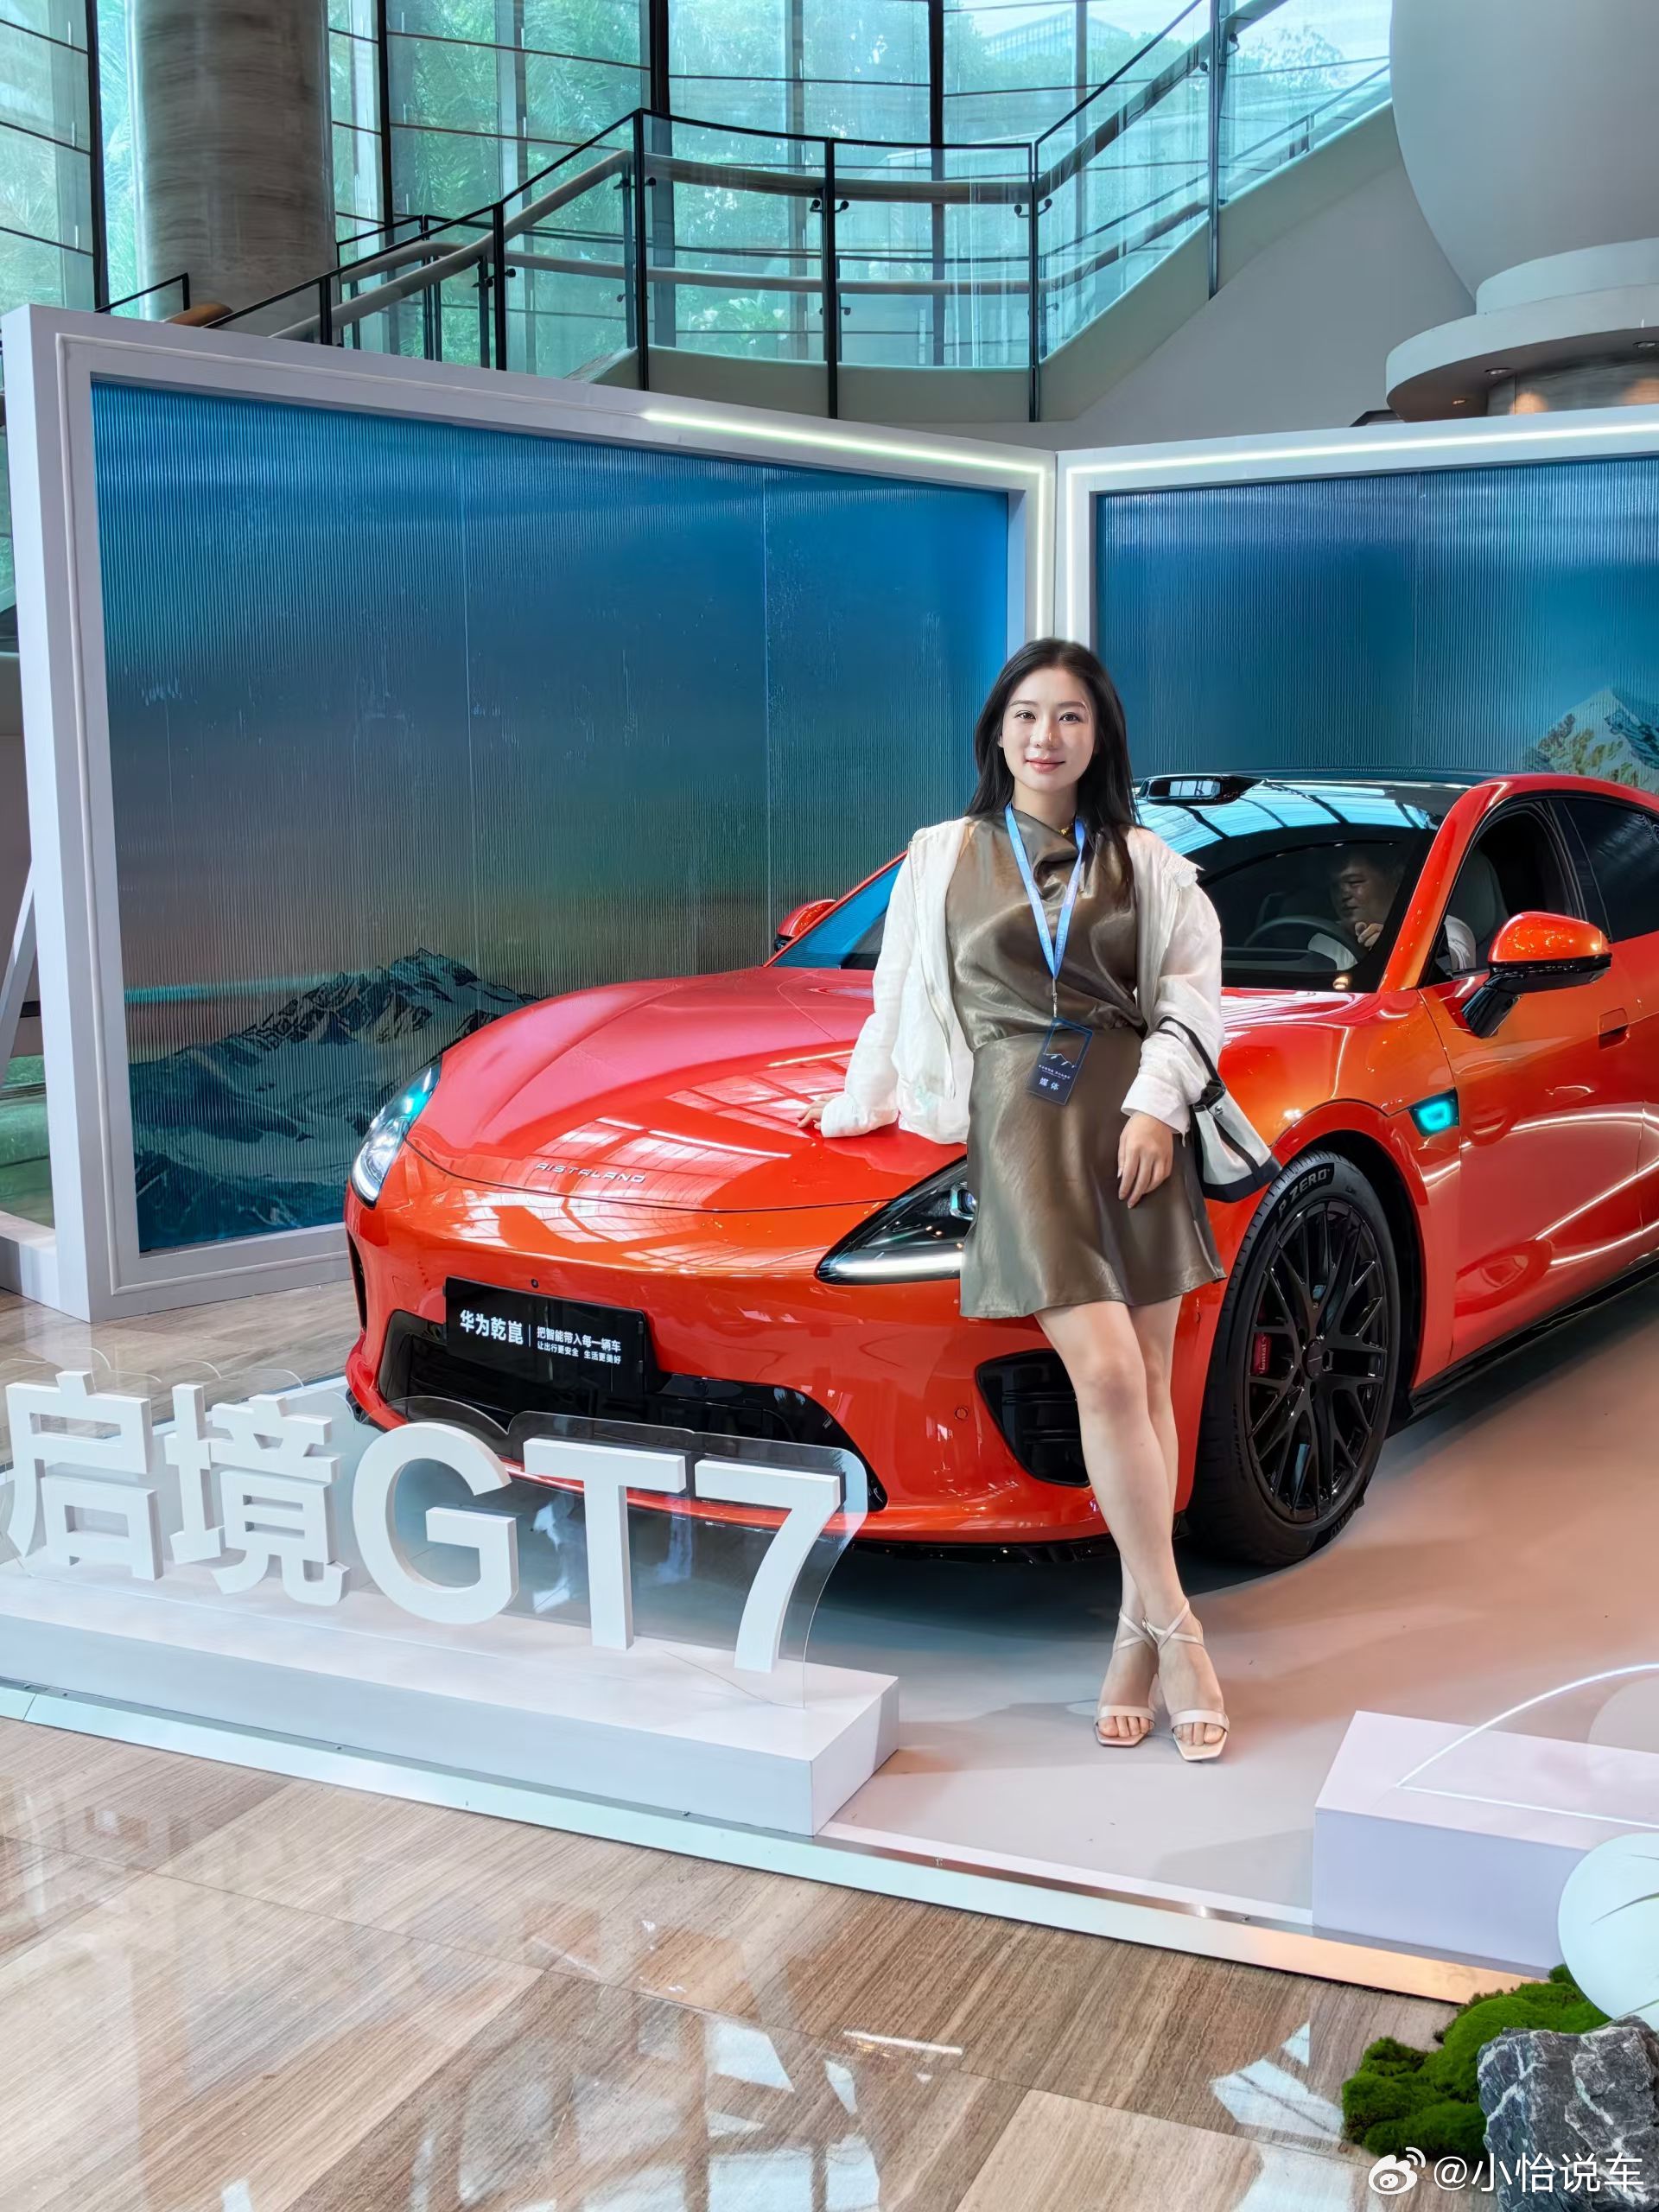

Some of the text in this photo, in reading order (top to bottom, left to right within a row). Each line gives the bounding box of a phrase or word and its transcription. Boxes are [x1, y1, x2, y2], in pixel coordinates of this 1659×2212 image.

[535, 1161, 646, 1184] AISTALAND
[1289, 1168, 1328, 1202] ZERO
[460, 1309, 524, 1345] 华为乾崑
[537, 1325, 621, 1353] 把智能带入每一辆车
[537, 1341, 621, 1365] 让出行更安全 生活更美好
[5, 1370, 841, 1672] 启境GT7
